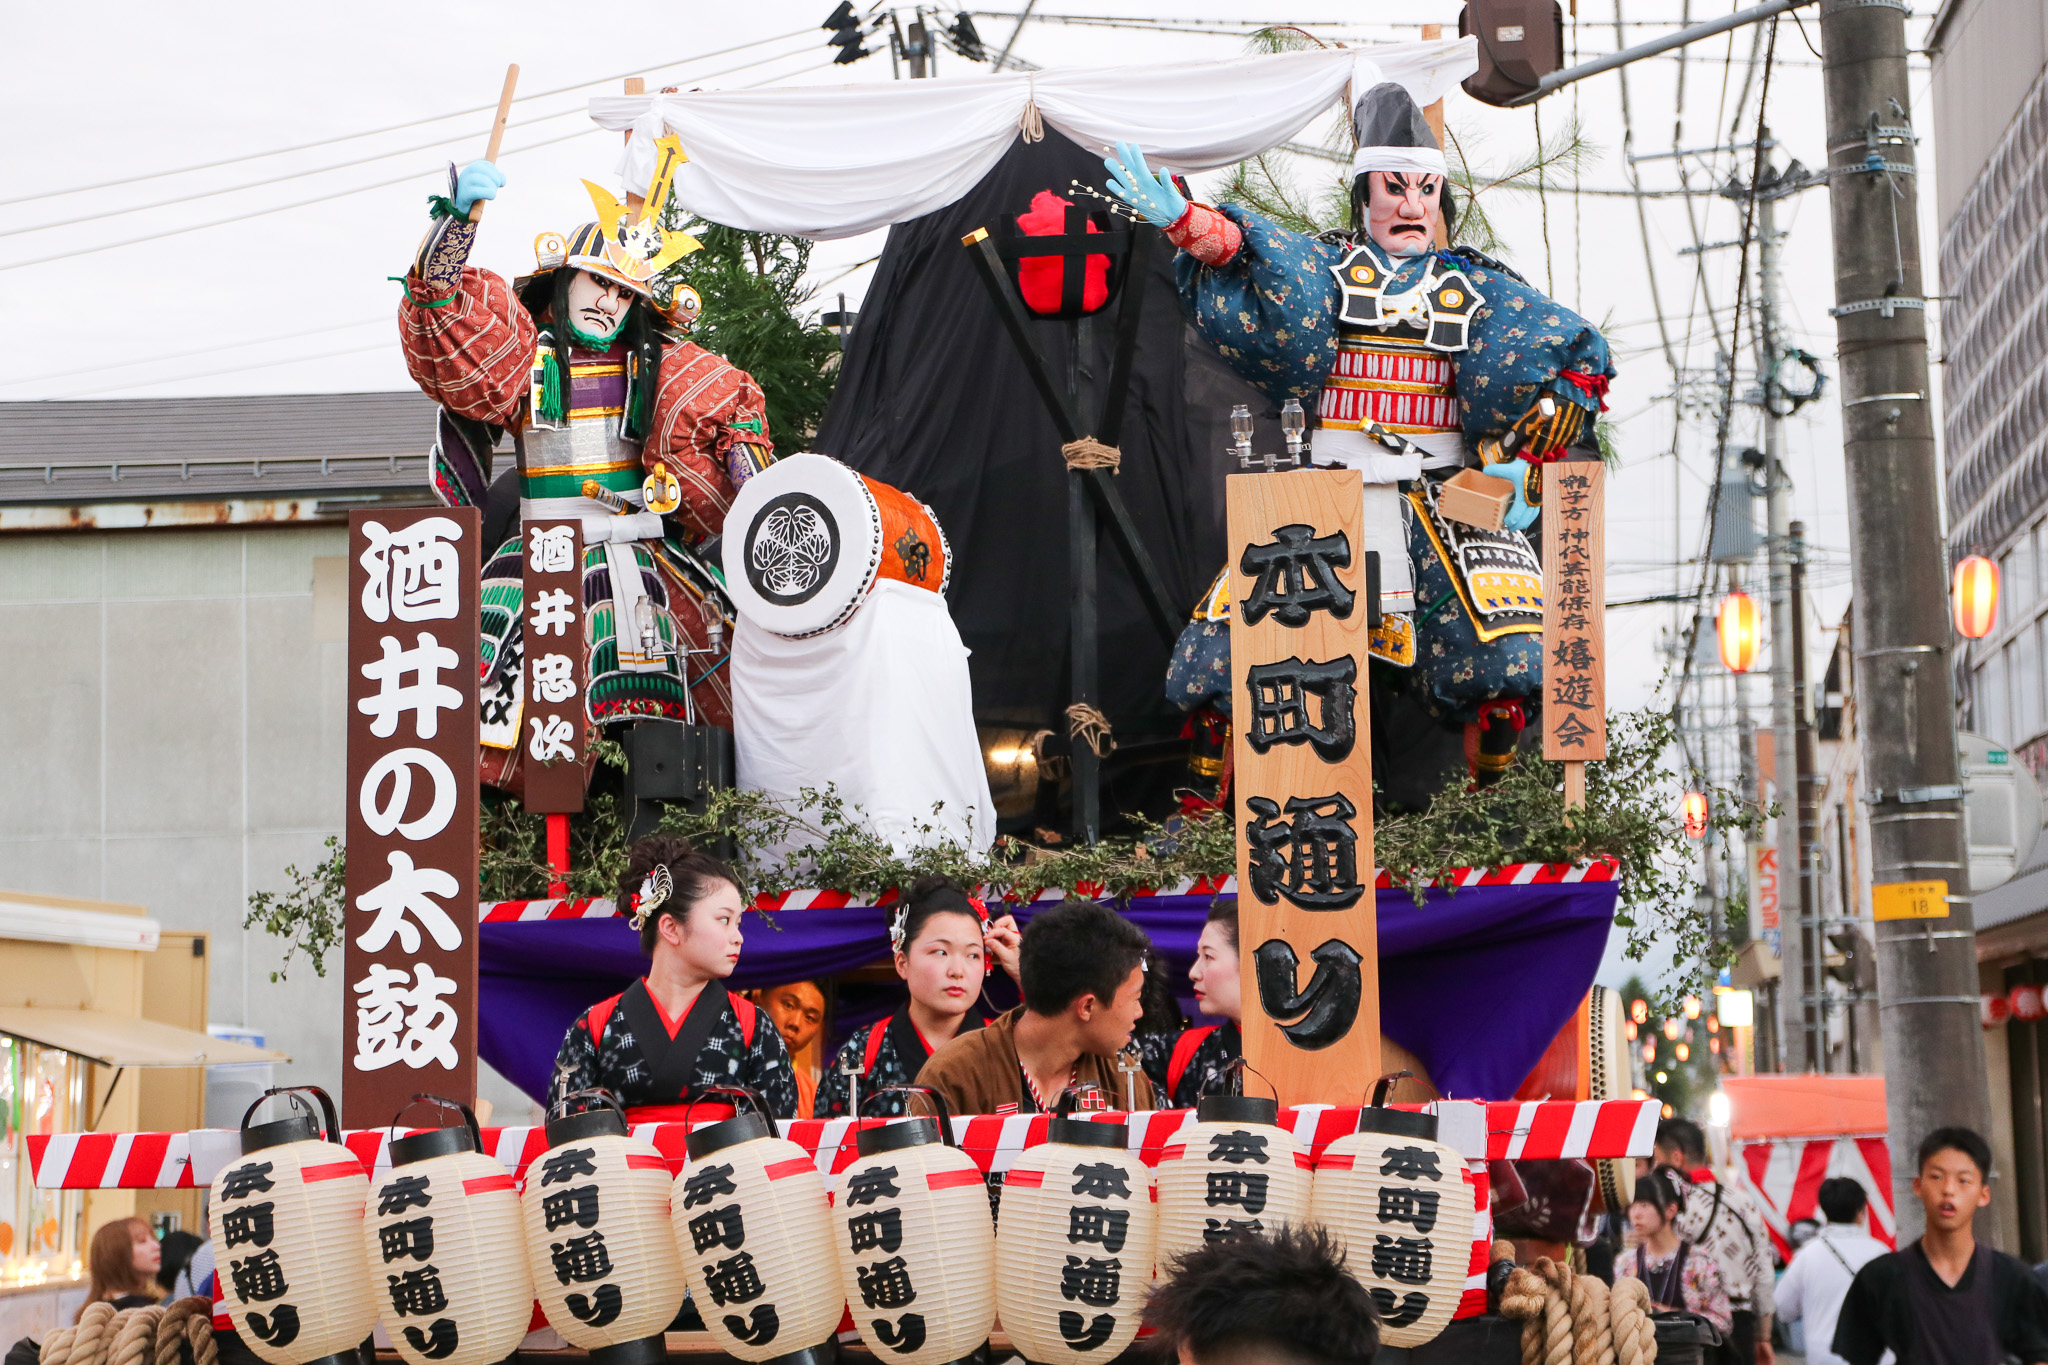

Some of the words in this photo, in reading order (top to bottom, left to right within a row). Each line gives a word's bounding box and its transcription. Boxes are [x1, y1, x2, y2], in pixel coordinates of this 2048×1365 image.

[529, 525, 578, 763] 酒井忠次
[1551, 637, 1596, 748] 嬉遊会
[353, 517, 464, 1072] 酒井の太鼓
[1240, 523, 1366, 1051] 本町通り
[1912, 899, 1929, 914] 18
[220, 1160, 301, 1348] 本町通り
[377, 1174, 460, 1361] 本町通り
[541, 1147, 624, 1328] 本町通り
[683, 1162, 780, 1347] 本町通り
[846, 1165, 927, 1354] 本町通り
[1057, 1162, 1132, 1352] 本町通り
[1369, 1145, 1442, 1329] 本町通り
